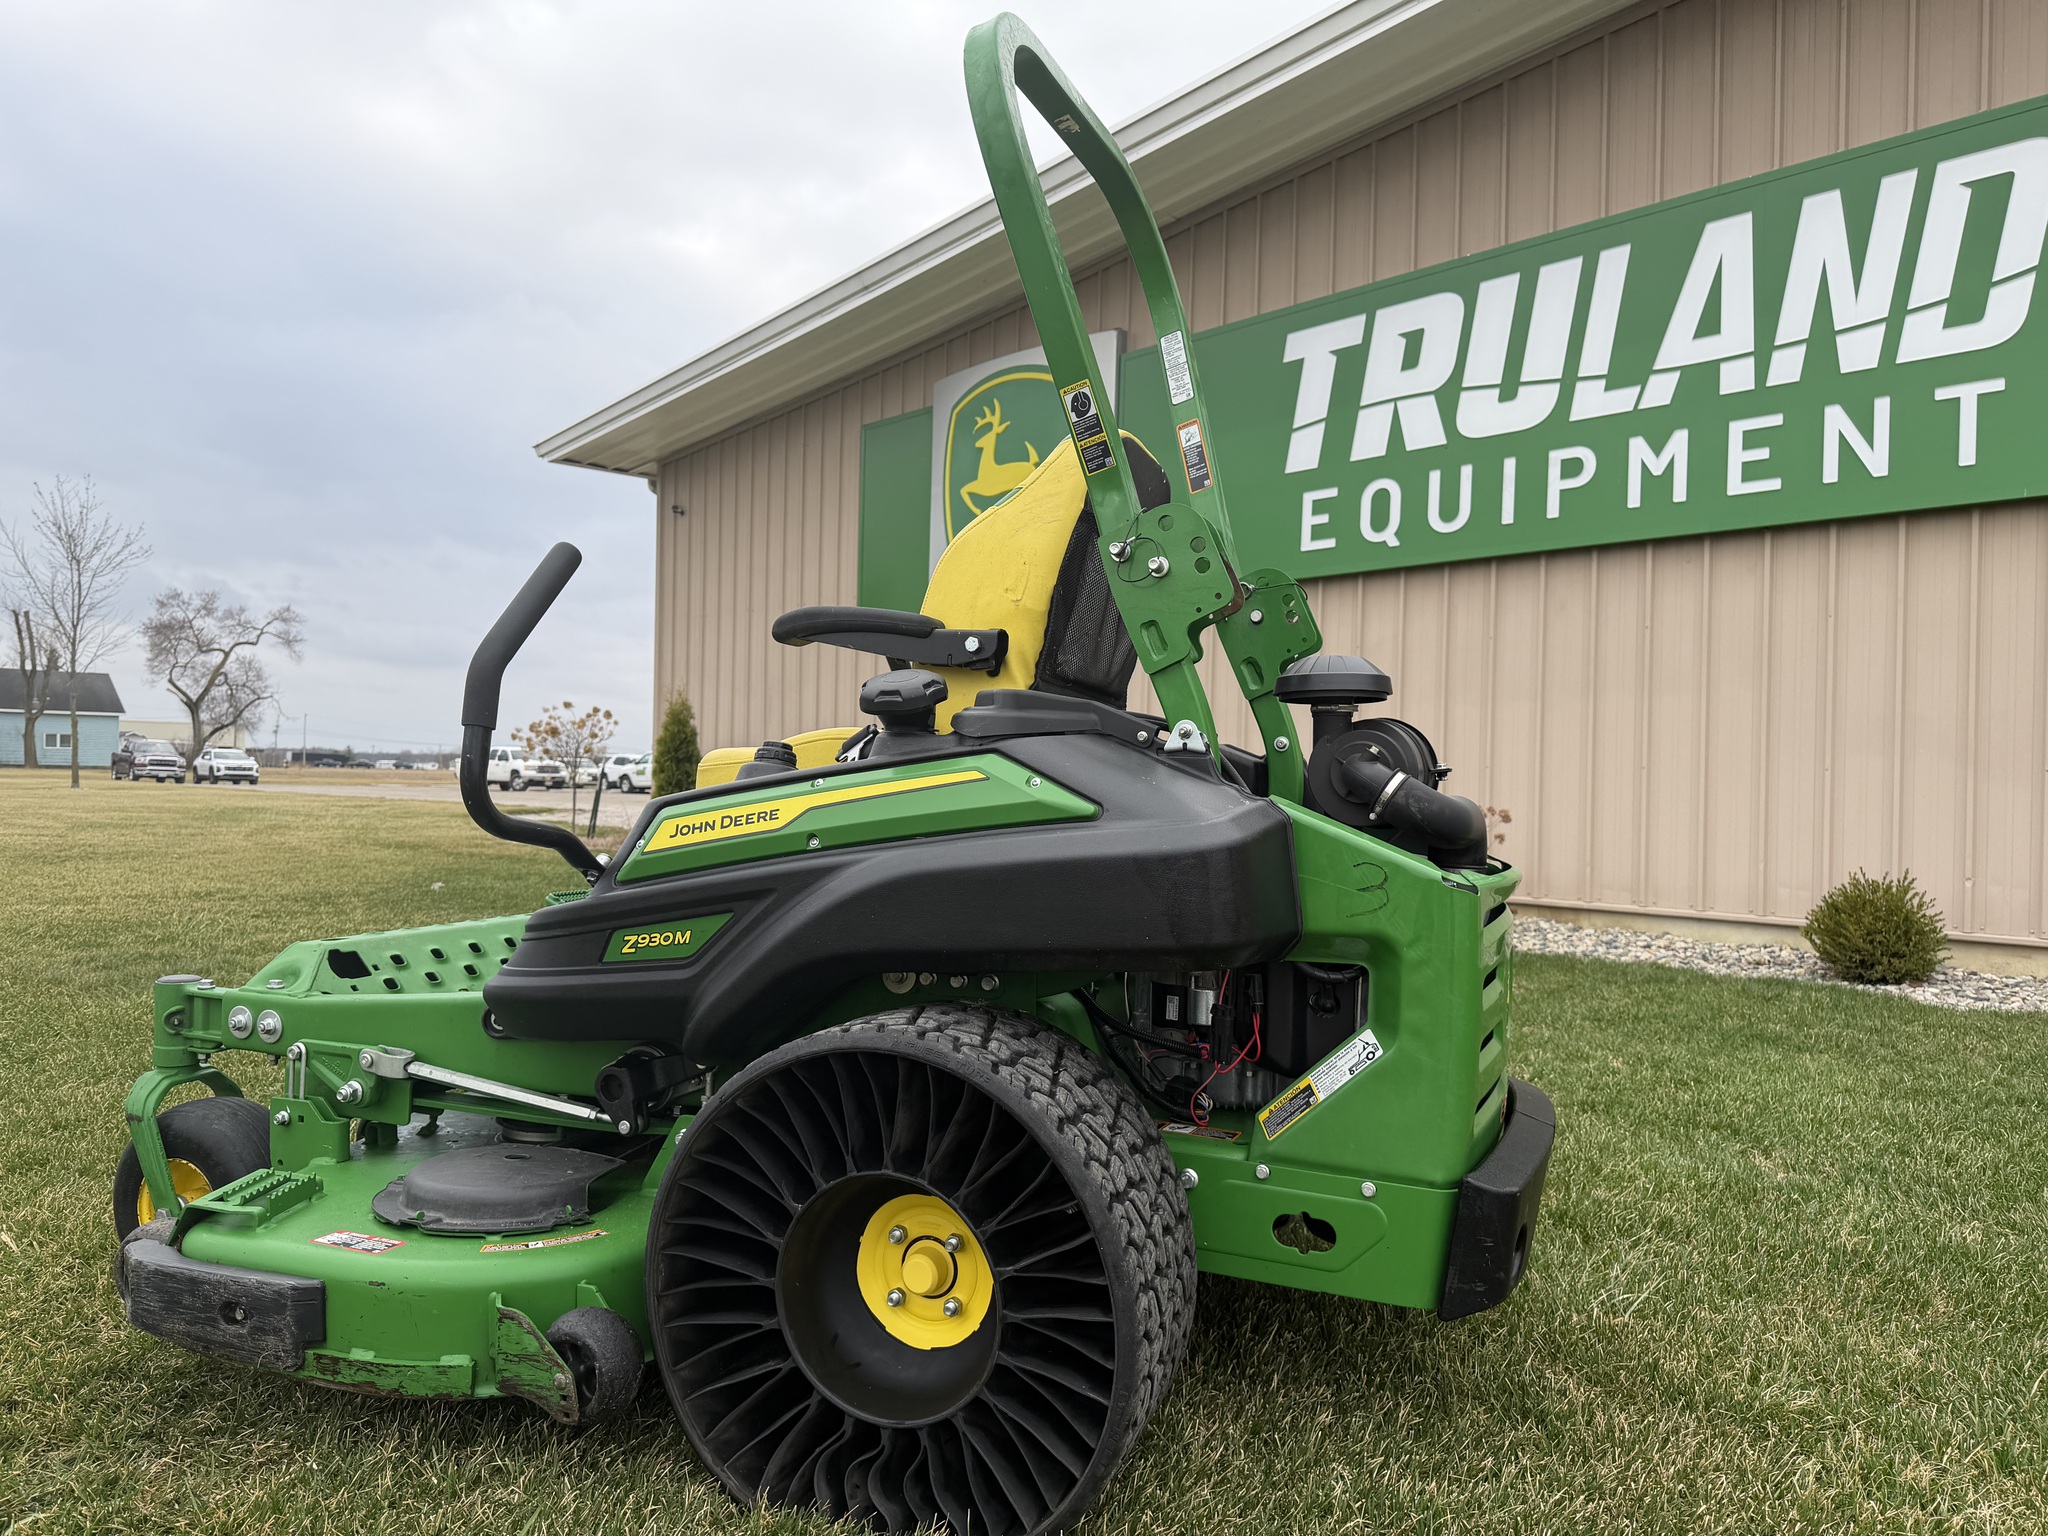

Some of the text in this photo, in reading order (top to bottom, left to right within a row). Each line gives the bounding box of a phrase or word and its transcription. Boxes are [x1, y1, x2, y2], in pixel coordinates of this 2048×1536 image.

[1282, 136, 2048, 474] TRULAND
[1300, 377, 2006, 551] EQUIPMENT
[669, 809, 780, 838] JOHN DEERE
[621, 930, 692, 954] Z930M
